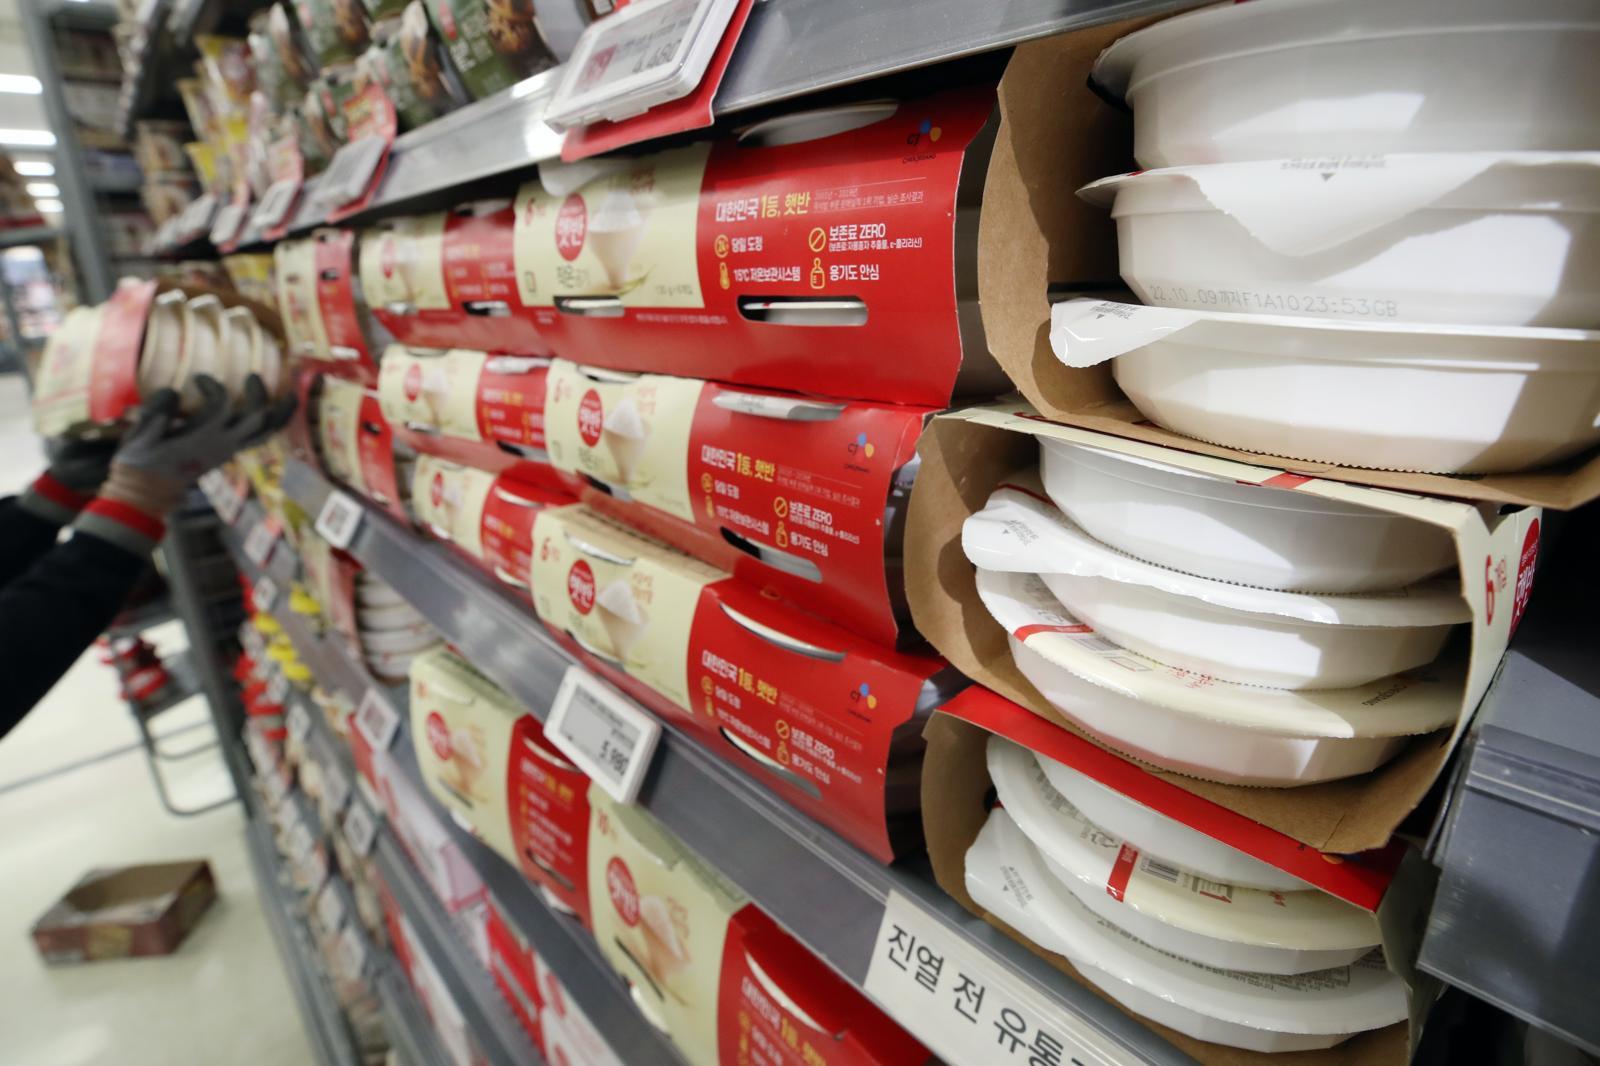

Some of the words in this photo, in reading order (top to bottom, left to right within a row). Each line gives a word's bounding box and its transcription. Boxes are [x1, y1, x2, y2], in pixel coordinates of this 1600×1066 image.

[716, 197, 758, 222] 대한민국
[784, 191, 810, 215] 햇반
[829, 225, 857, 241] 보존료
[860, 223, 886, 238] ZERO
[829, 265, 858, 281] 용기도
[860, 264, 879, 280] 안심
[701, 444, 736, 472] 대한민국
[754, 457, 776, 482] 햇반
[812, 507, 832, 526] ZERO
[888, 924, 944, 993] 진열
[953, 972, 986, 1024] 전
[993, 1007, 1085, 1066] 유통
